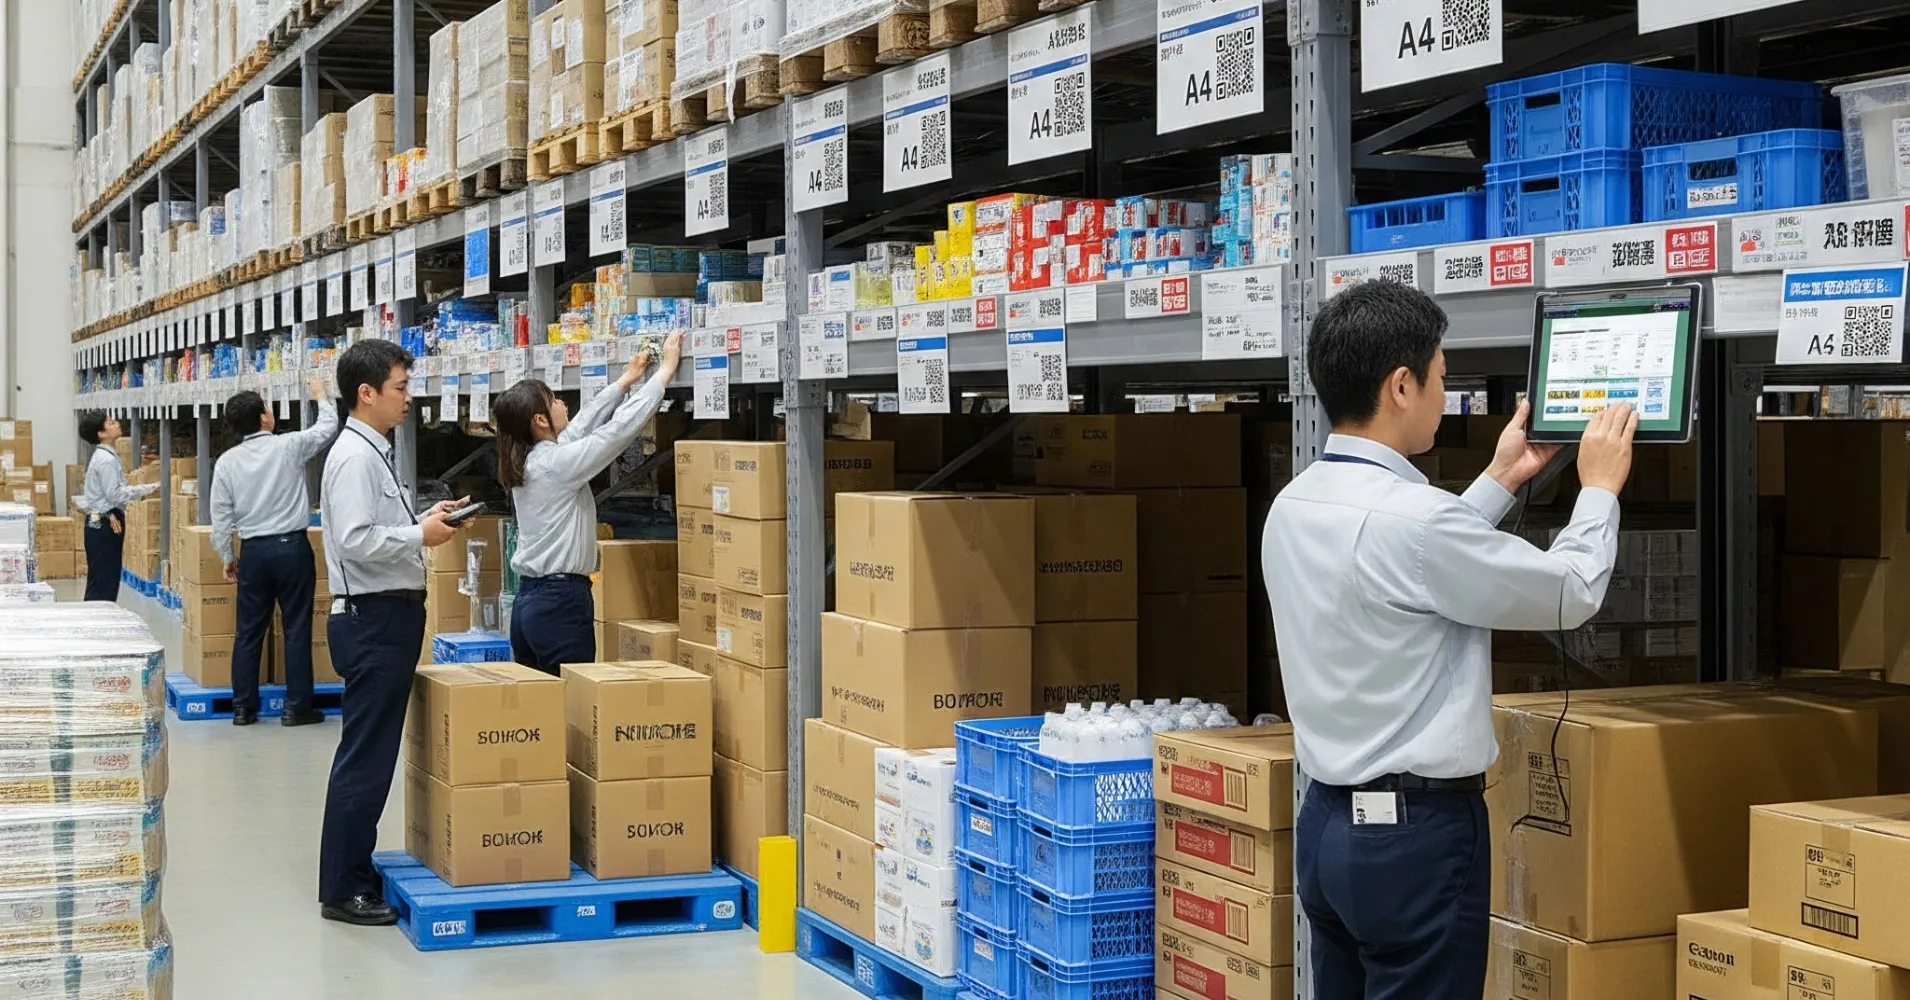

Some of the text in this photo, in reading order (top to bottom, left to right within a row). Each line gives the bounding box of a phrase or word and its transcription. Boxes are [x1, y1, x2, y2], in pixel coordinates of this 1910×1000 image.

[1398, 17, 1435, 59] A4
[1185, 70, 1212, 106] A4
[1029, 108, 1052, 140] A4
[901, 145, 918, 172] A4
